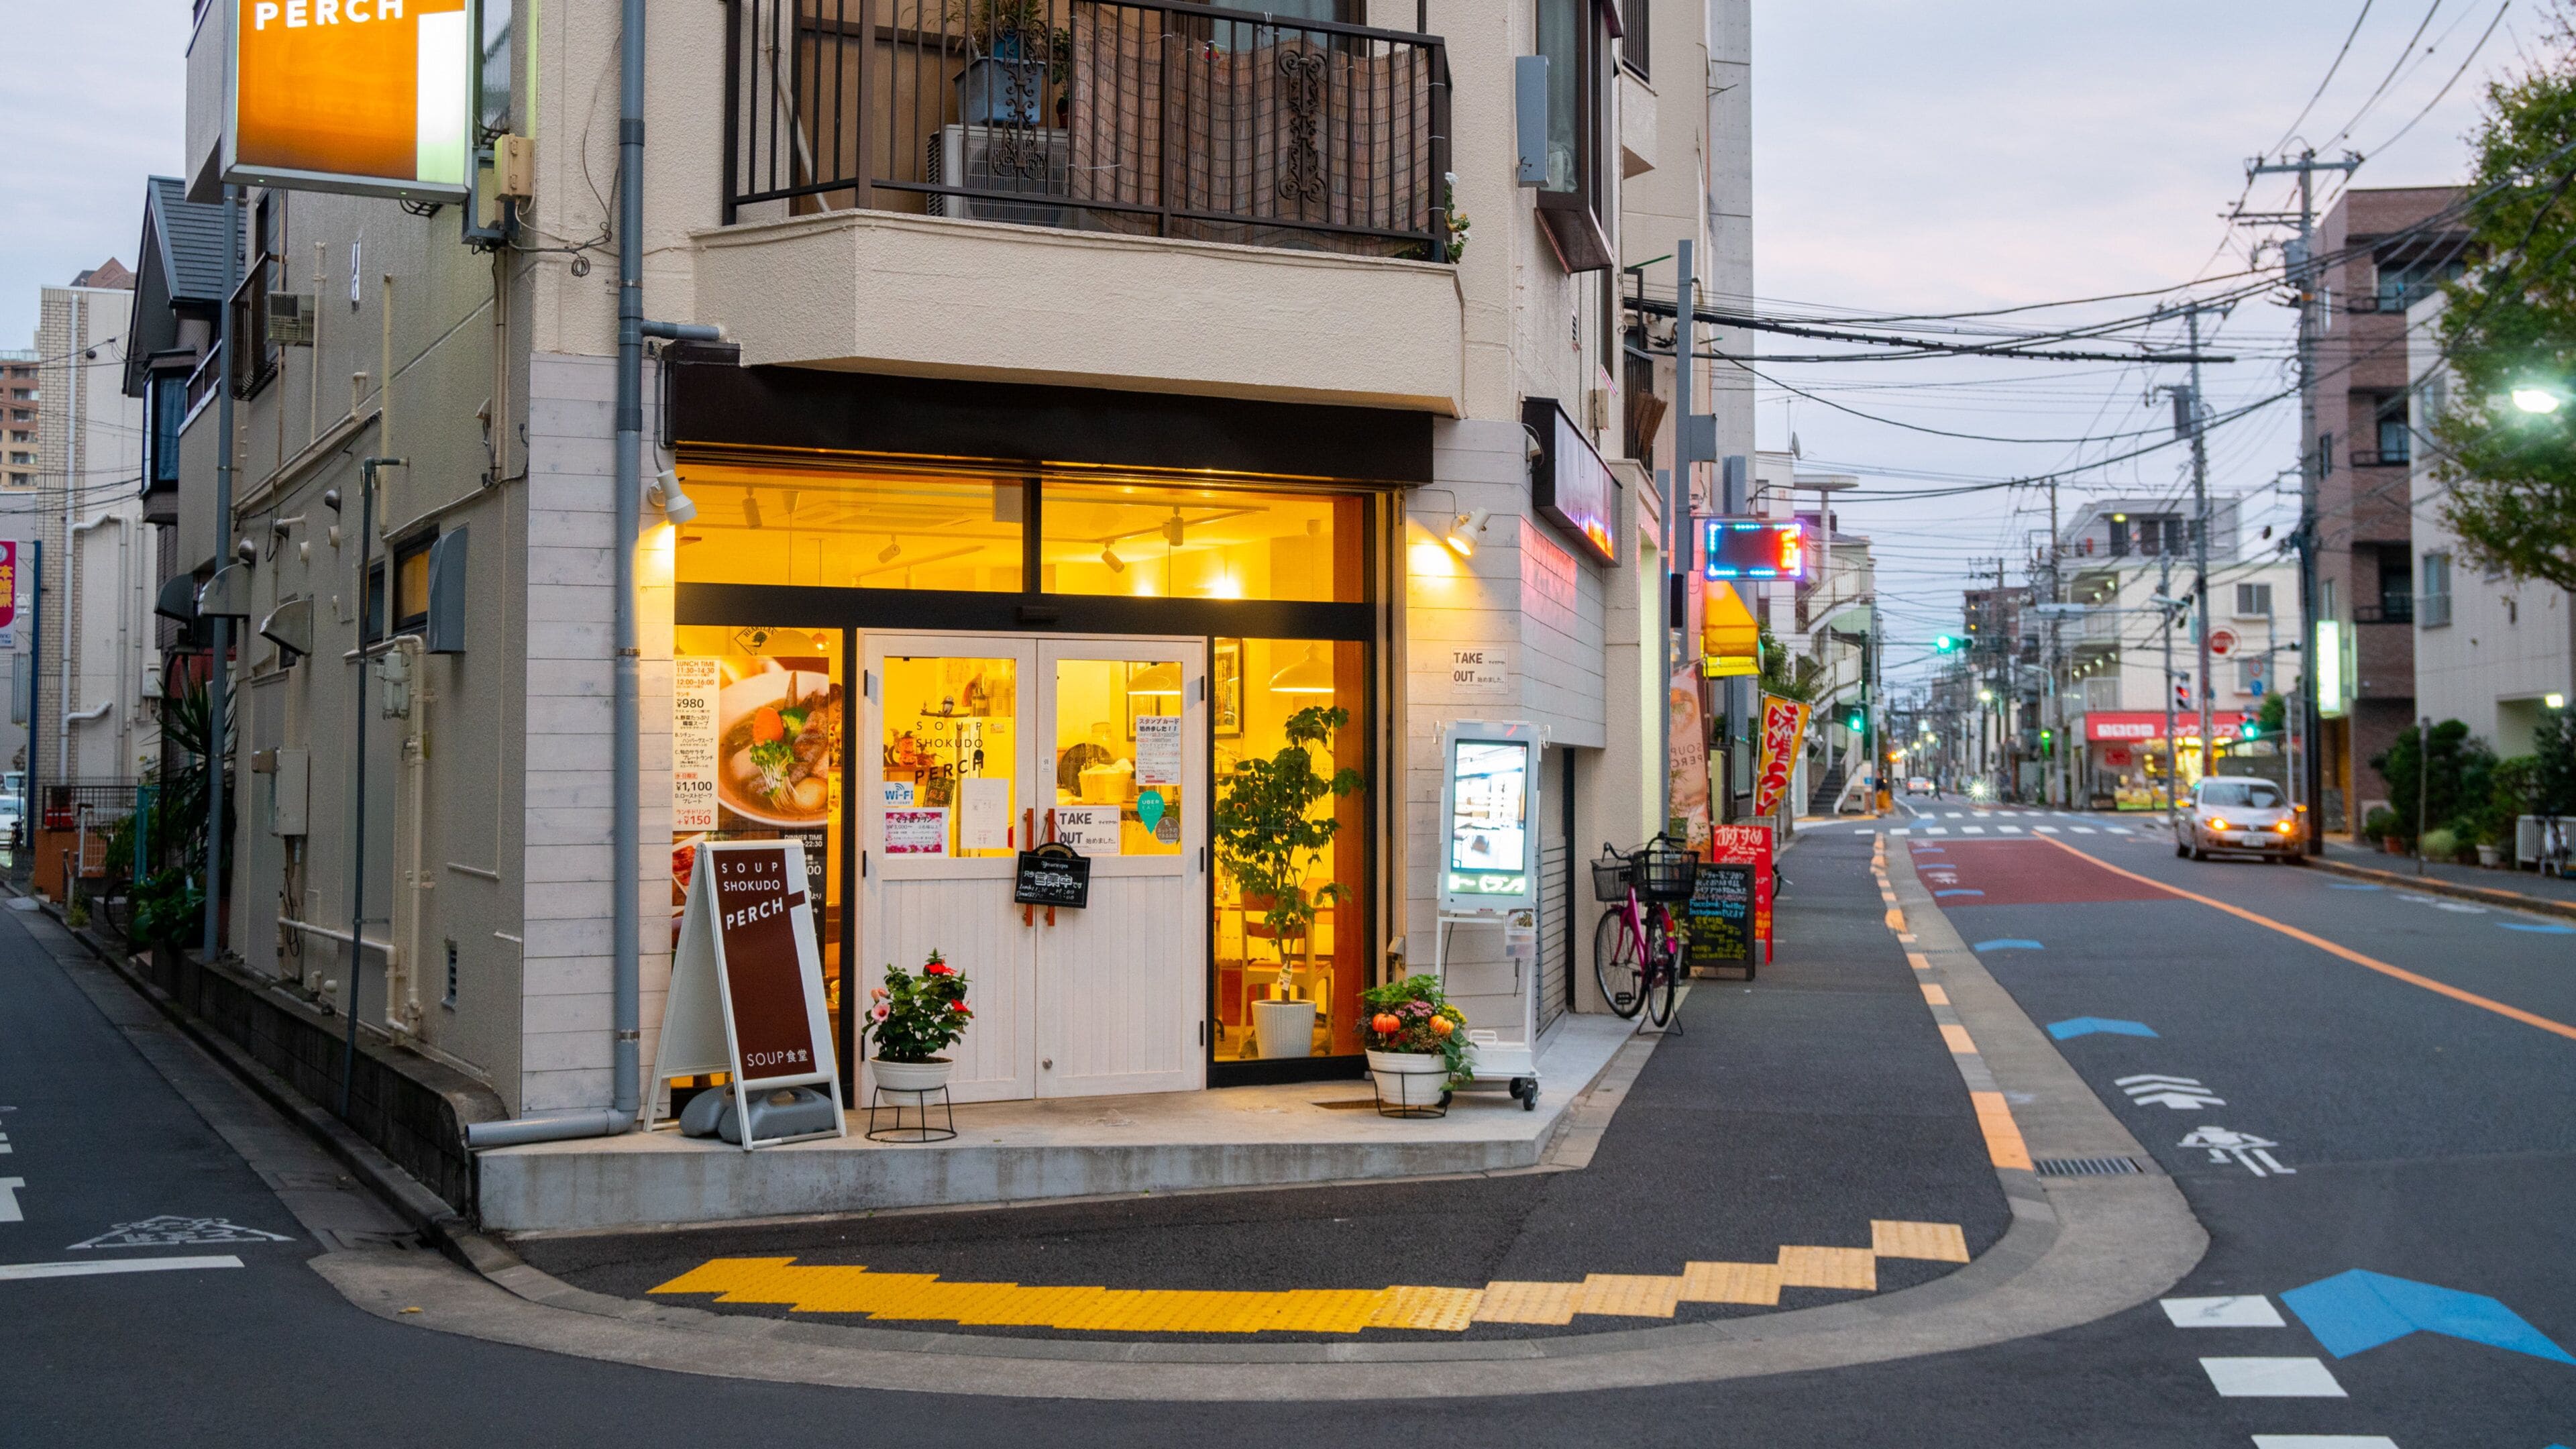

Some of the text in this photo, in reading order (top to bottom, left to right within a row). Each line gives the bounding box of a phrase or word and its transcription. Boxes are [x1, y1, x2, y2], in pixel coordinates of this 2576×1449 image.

[255, 0, 403, 30] PERCH
[1454, 652, 1483, 664] TAKE
[1454, 670, 1474, 682] OUT
[677, 698, 704, 708] ¥980
[916, 721, 982, 731] SOUP
[916, 739, 983, 748] SHOKUDO
[915, 757, 983, 784] PERCH
[676, 782, 712, 792] ¥1,100
[885, 790, 913, 800] Wi-Fi
[1059, 812, 1092, 824] TAKE
[1059, 832, 1083, 844] OUT
[1715, 826, 1763, 847] おすすめ
[1727, 843, 1766, 856] メニュー
[722, 862, 778, 874] SOUP
[724, 879, 780, 892] SHOKUDO
[726, 897, 784, 930] PERCH
[747, 1049, 808, 1067] SOUP食堂
